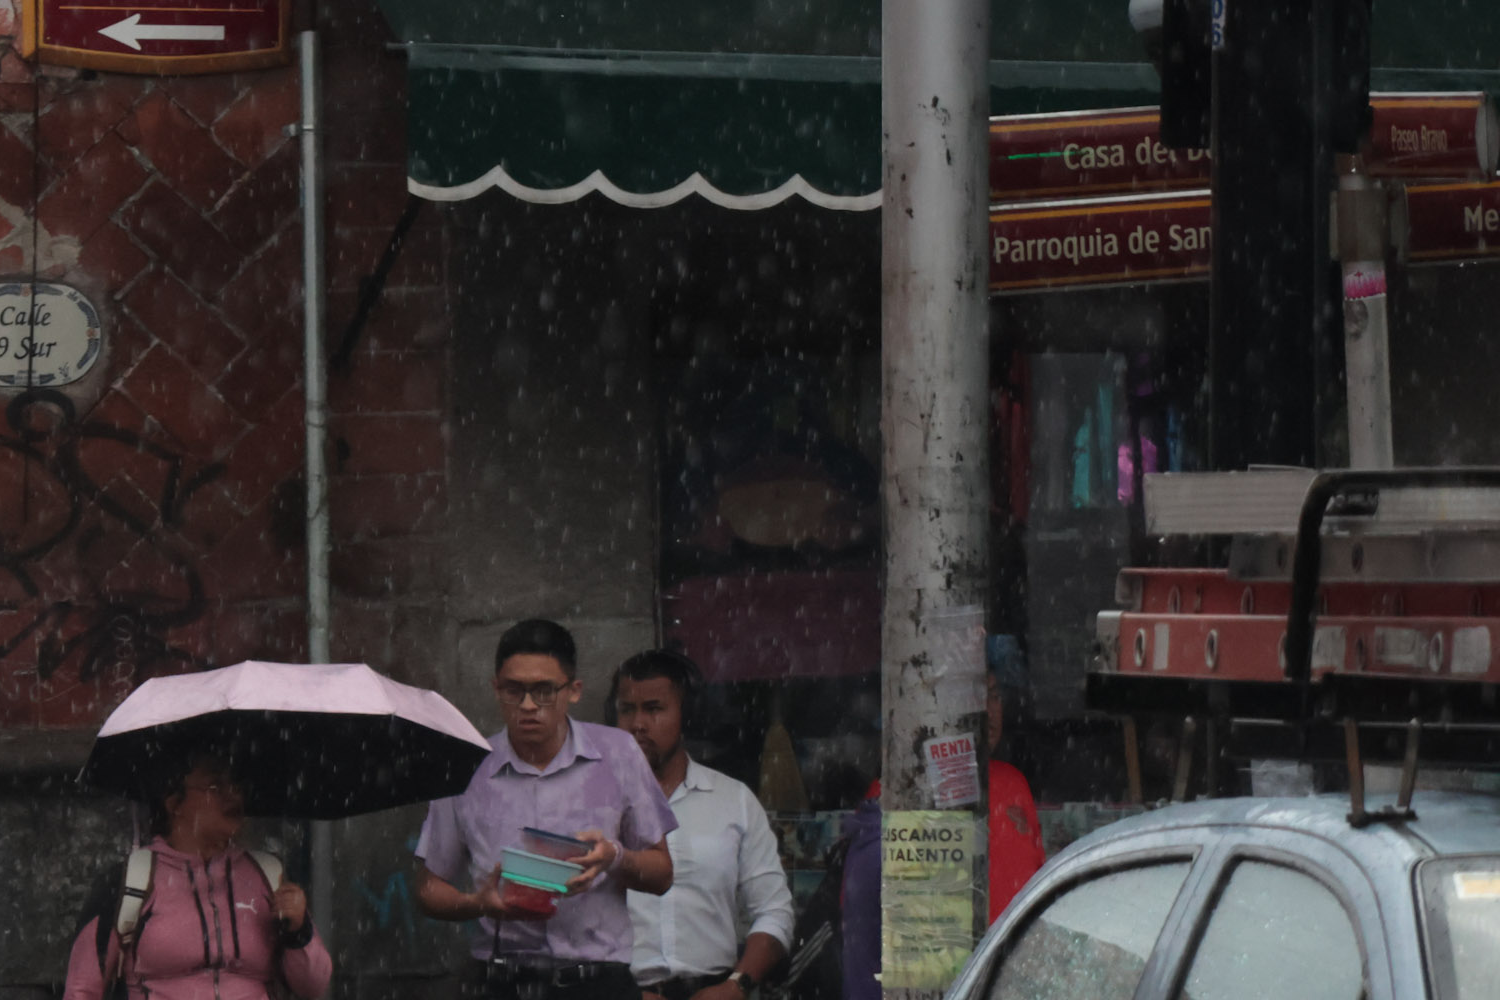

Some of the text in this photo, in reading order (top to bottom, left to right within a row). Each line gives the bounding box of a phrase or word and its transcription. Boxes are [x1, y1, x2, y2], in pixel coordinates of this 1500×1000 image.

[1064, 143, 1125, 170] Casa
[1464, 203, 1500, 232] Me
[995, 228, 1119, 266] Parroquia
[1128, 225, 1160, 254] de
[0, 303, 52, 326] Calle
[14, 337, 57, 360] Sur
[930, 738, 973, 759] RENTA
